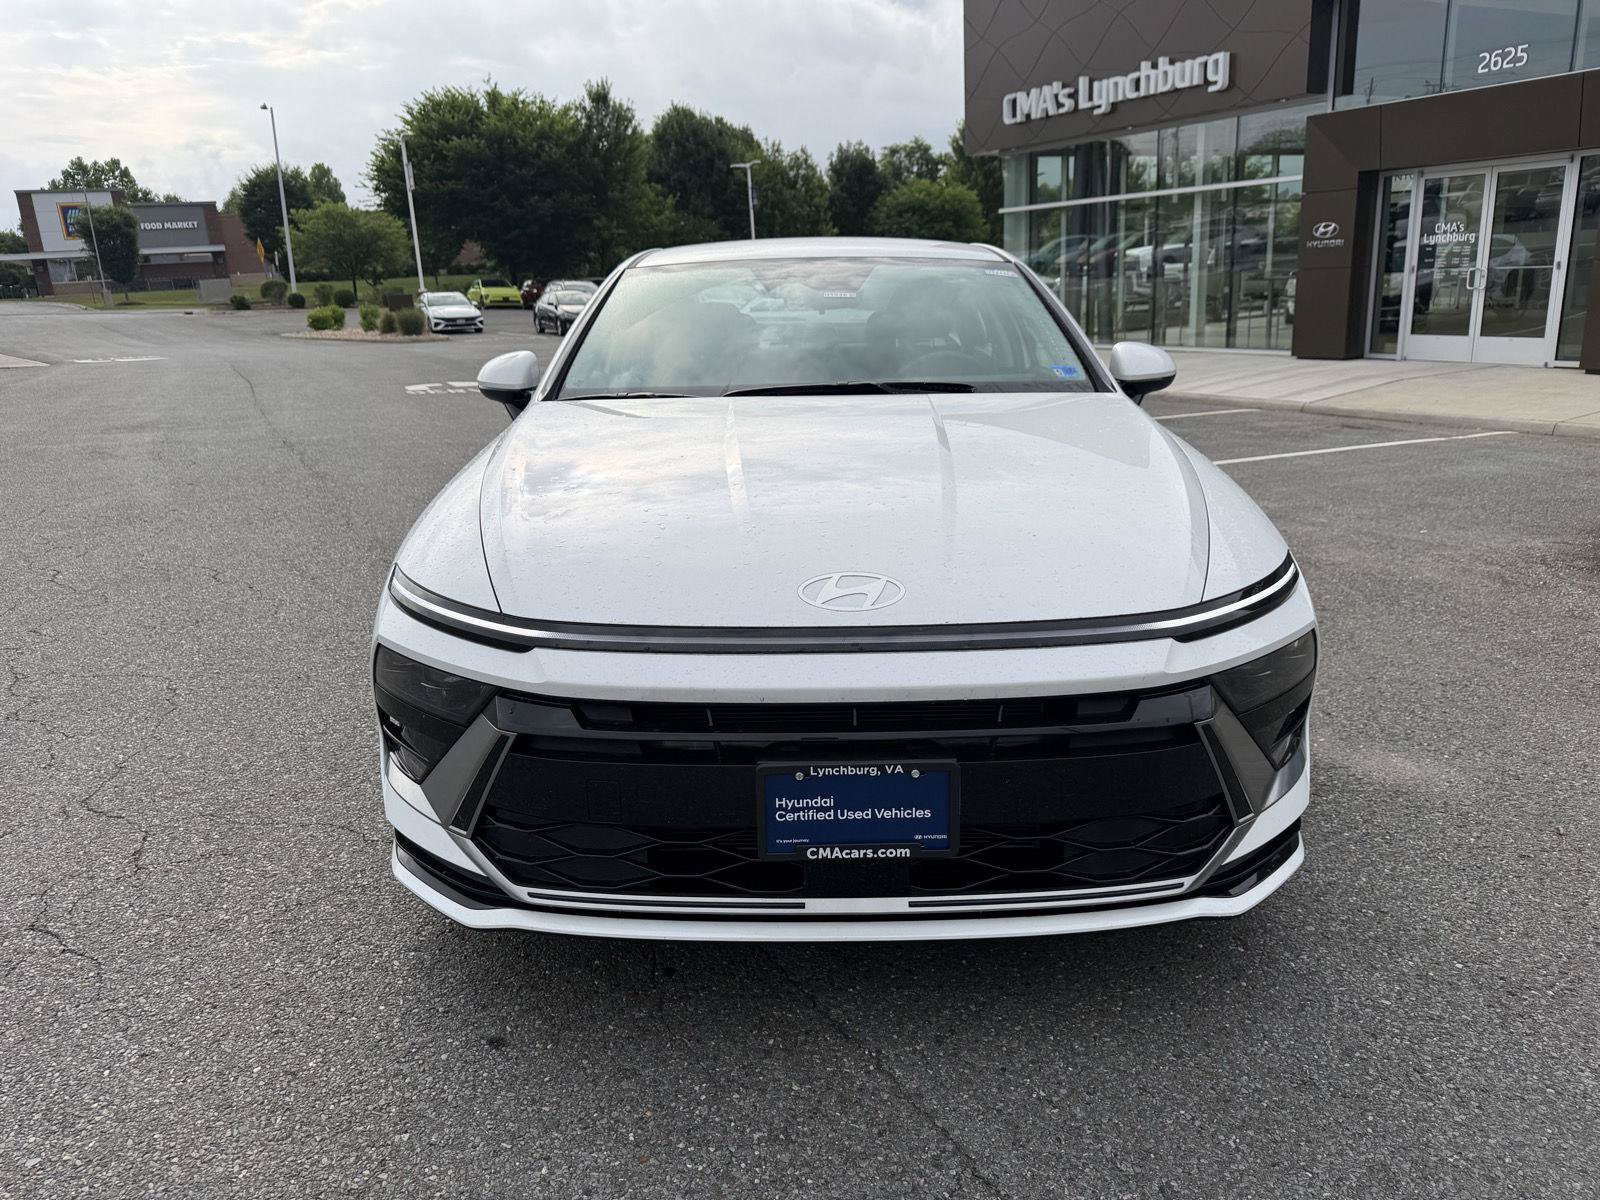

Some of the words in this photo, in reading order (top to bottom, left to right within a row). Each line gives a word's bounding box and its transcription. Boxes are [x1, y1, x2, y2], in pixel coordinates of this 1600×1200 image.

[1477, 44, 1529, 74] 2625
[1002, 81, 1076, 126] CMA's
[1078, 51, 1231, 116] Lynchburg
[140, 222, 162, 230] FOOD
[164, 221, 198, 230] MARKET
[1434, 221, 1465, 234] CMA's
[1306, 238, 1345, 249] HYUNDAI
[1423, 232, 1476, 246] Lynchburg
[810, 765, 881, 777] Lynchburg,
[885, 764, 904, 774] VA
[775, 795, 834, 810] Hyundai
[775, 809, 834, 822] Certified
[837, 808, 872, 820] Used
[874, 807, 932, 819] Vehicles
[806, 846, 911, 860] CMAcars.com
